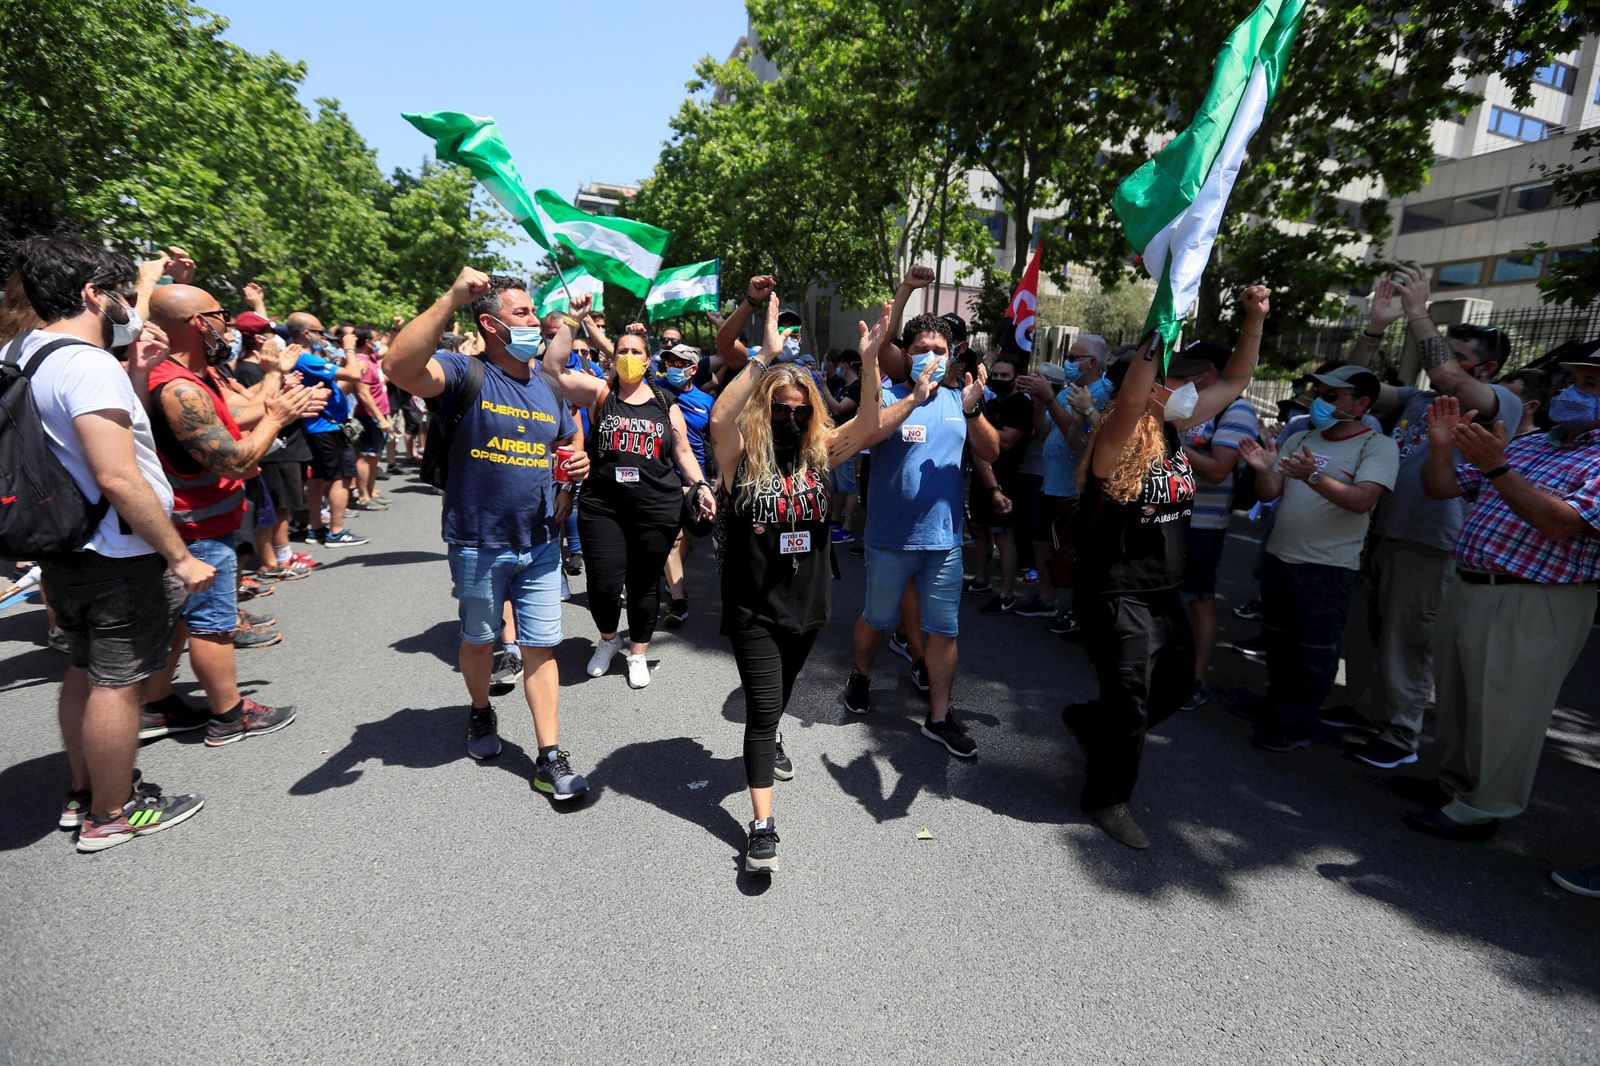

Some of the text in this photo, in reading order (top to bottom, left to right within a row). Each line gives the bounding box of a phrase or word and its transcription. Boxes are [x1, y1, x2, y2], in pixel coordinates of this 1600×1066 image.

[481, 400, 557, 424] PUERTO REAL
[602, 414, 664, 438] COMANDO
[486, 436, 546, 455] AIRBUS
[470, 448, 549, 468] OPERACIONES
[1153, 511, 1180, 524] AIRBUS
[787, 538, 804, 547] NO
